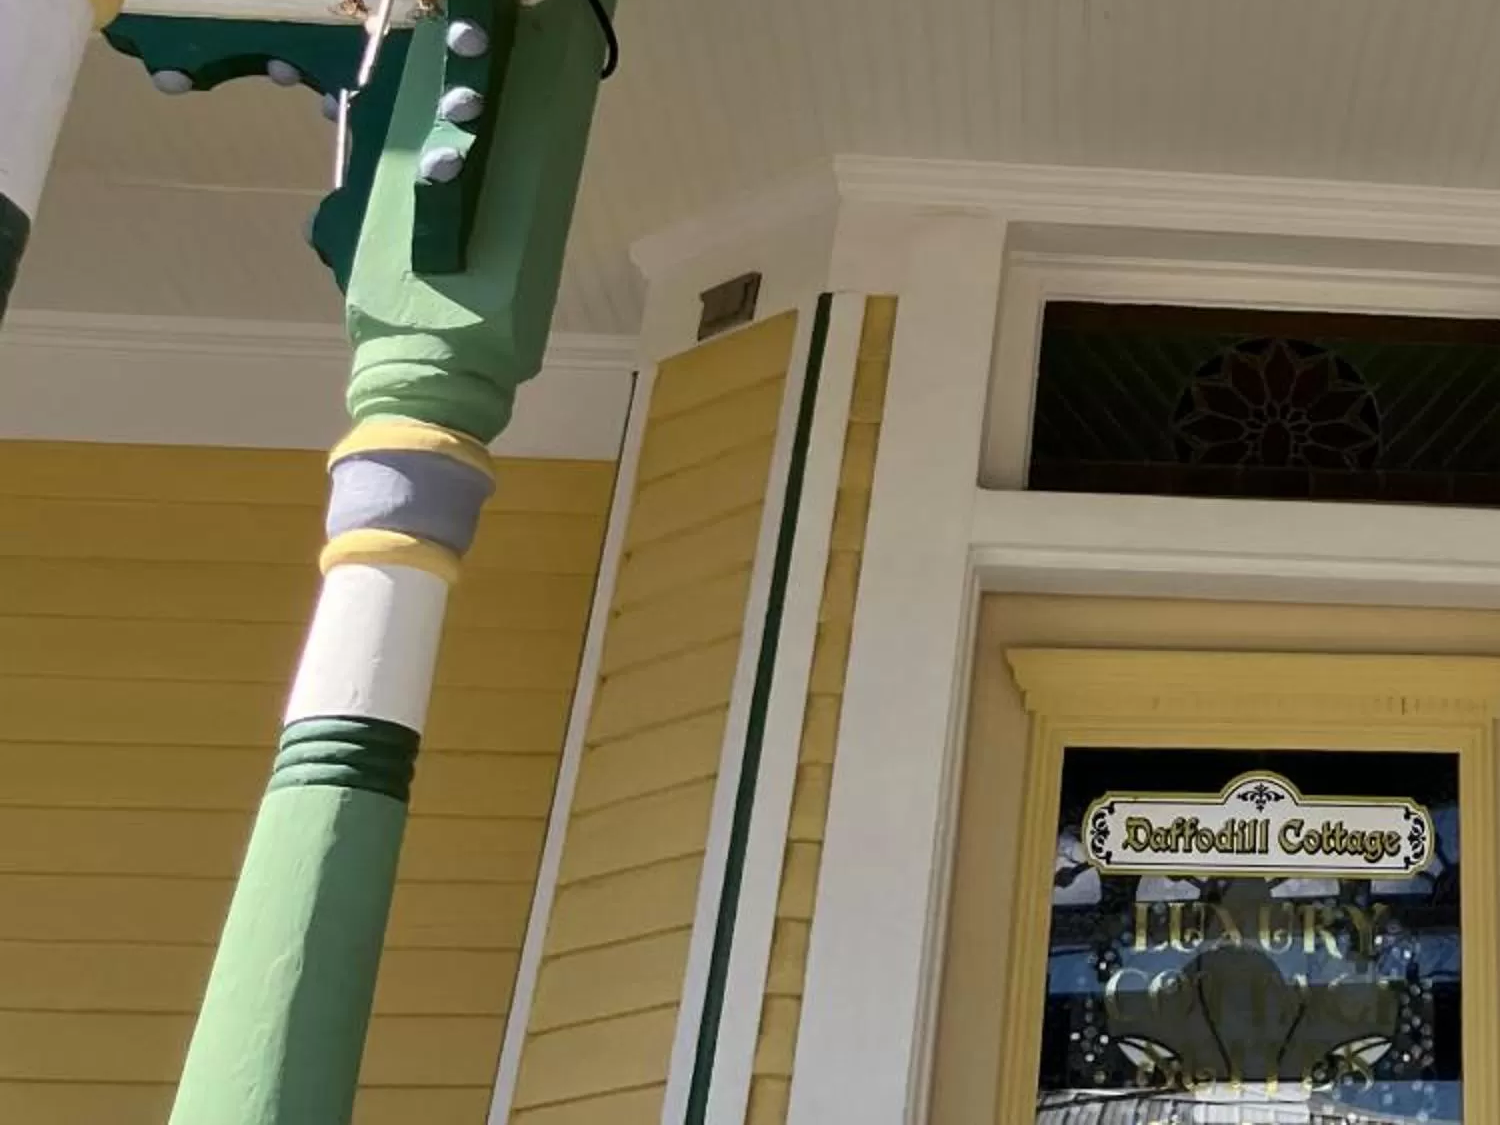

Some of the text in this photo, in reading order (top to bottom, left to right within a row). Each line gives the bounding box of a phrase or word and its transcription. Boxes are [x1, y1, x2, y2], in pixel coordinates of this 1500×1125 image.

[1122, 816, 1402, 861] Daffodill Cottage
[1132, 901, 1391, 961] LUXURY
